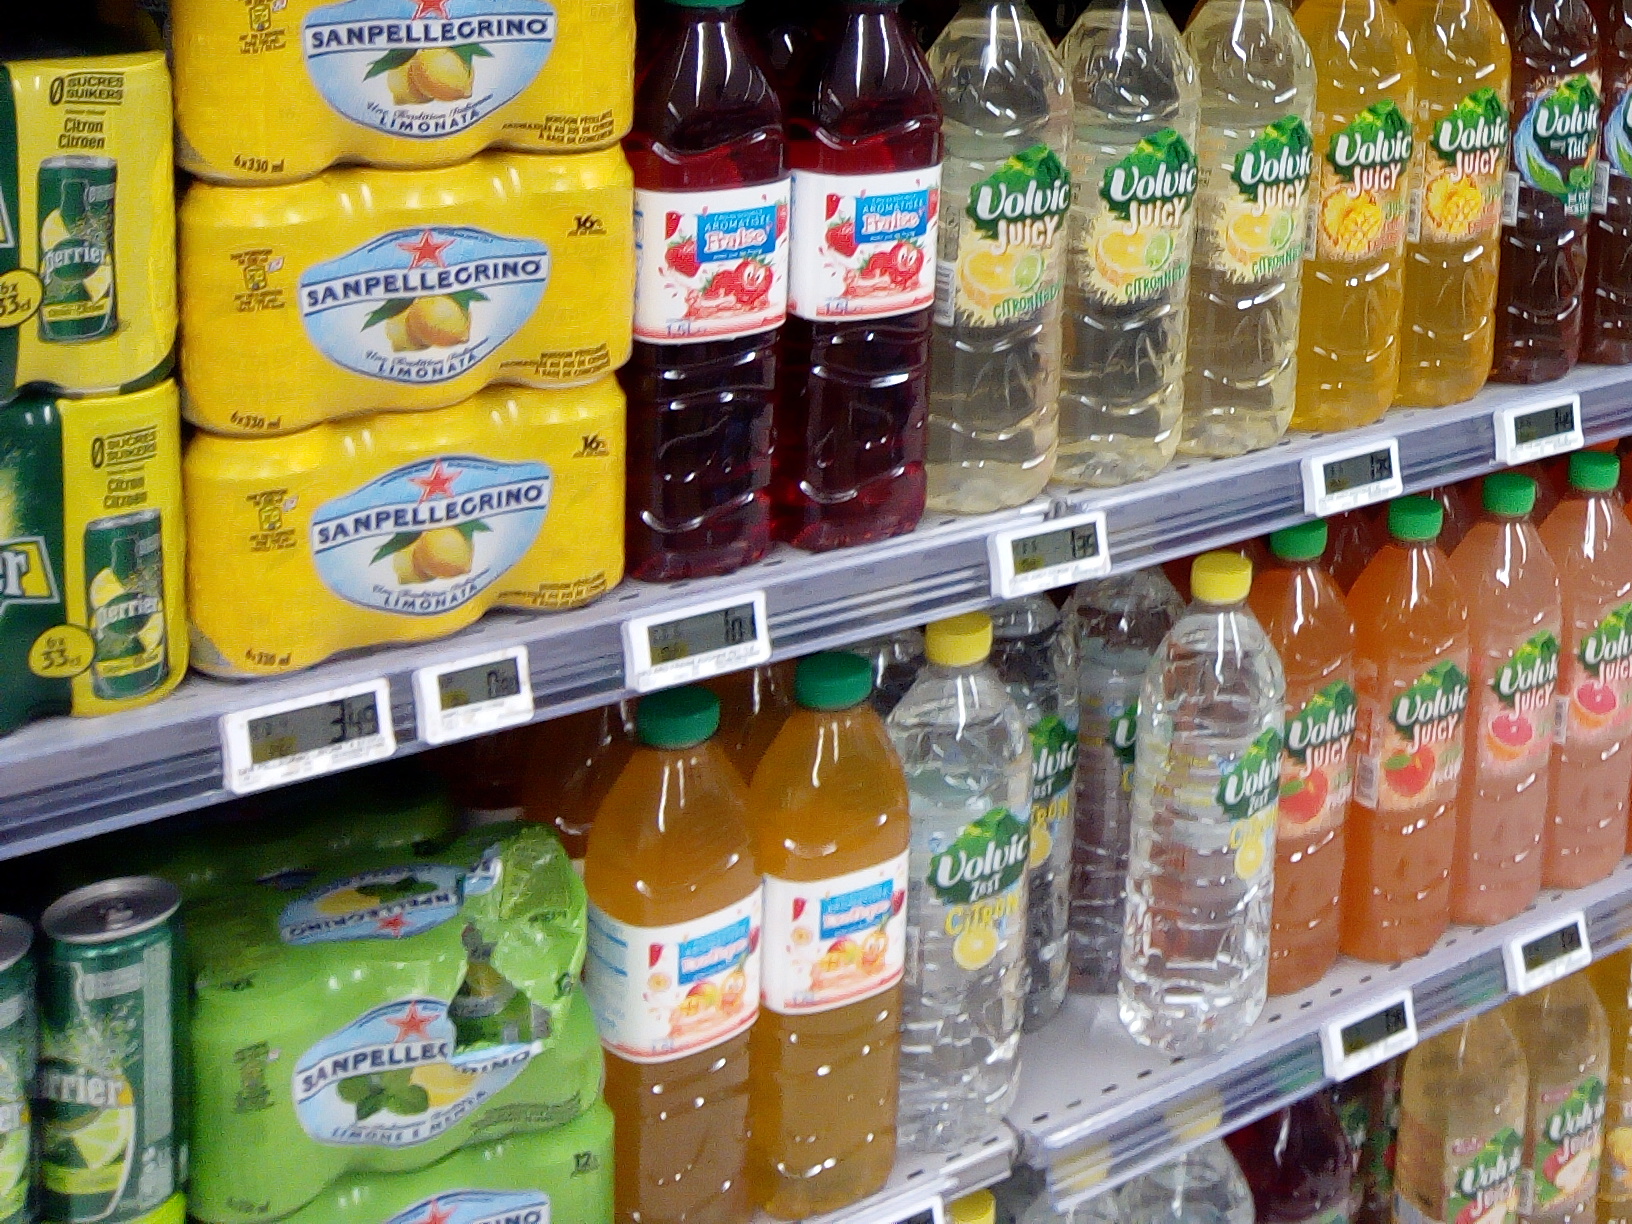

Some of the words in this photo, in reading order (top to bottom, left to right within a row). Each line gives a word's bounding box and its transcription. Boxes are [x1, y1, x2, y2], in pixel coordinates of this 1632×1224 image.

[311, 16, 549, 49] SANPELLEGRINO
[64, 117, 104, 134] Citron
[378, 107, 481, 135] LIMONATA
[58, 132, 106, 150] Citroen
[1334, 132, 1412, 167] Volvic
[1111, 162, 1198, 202] Volvic
[976, 179, 1071, 221] Volvic
[306, 256, 544, 307] SANPELLEGRINO
[377, 353, 479, 380] LIMONATA
[317, 484, 544, 545] SANPELLEGRINO
[384, 581, 479, 613] LIMONATA
[936, 833, 1028, 889] Volvic
